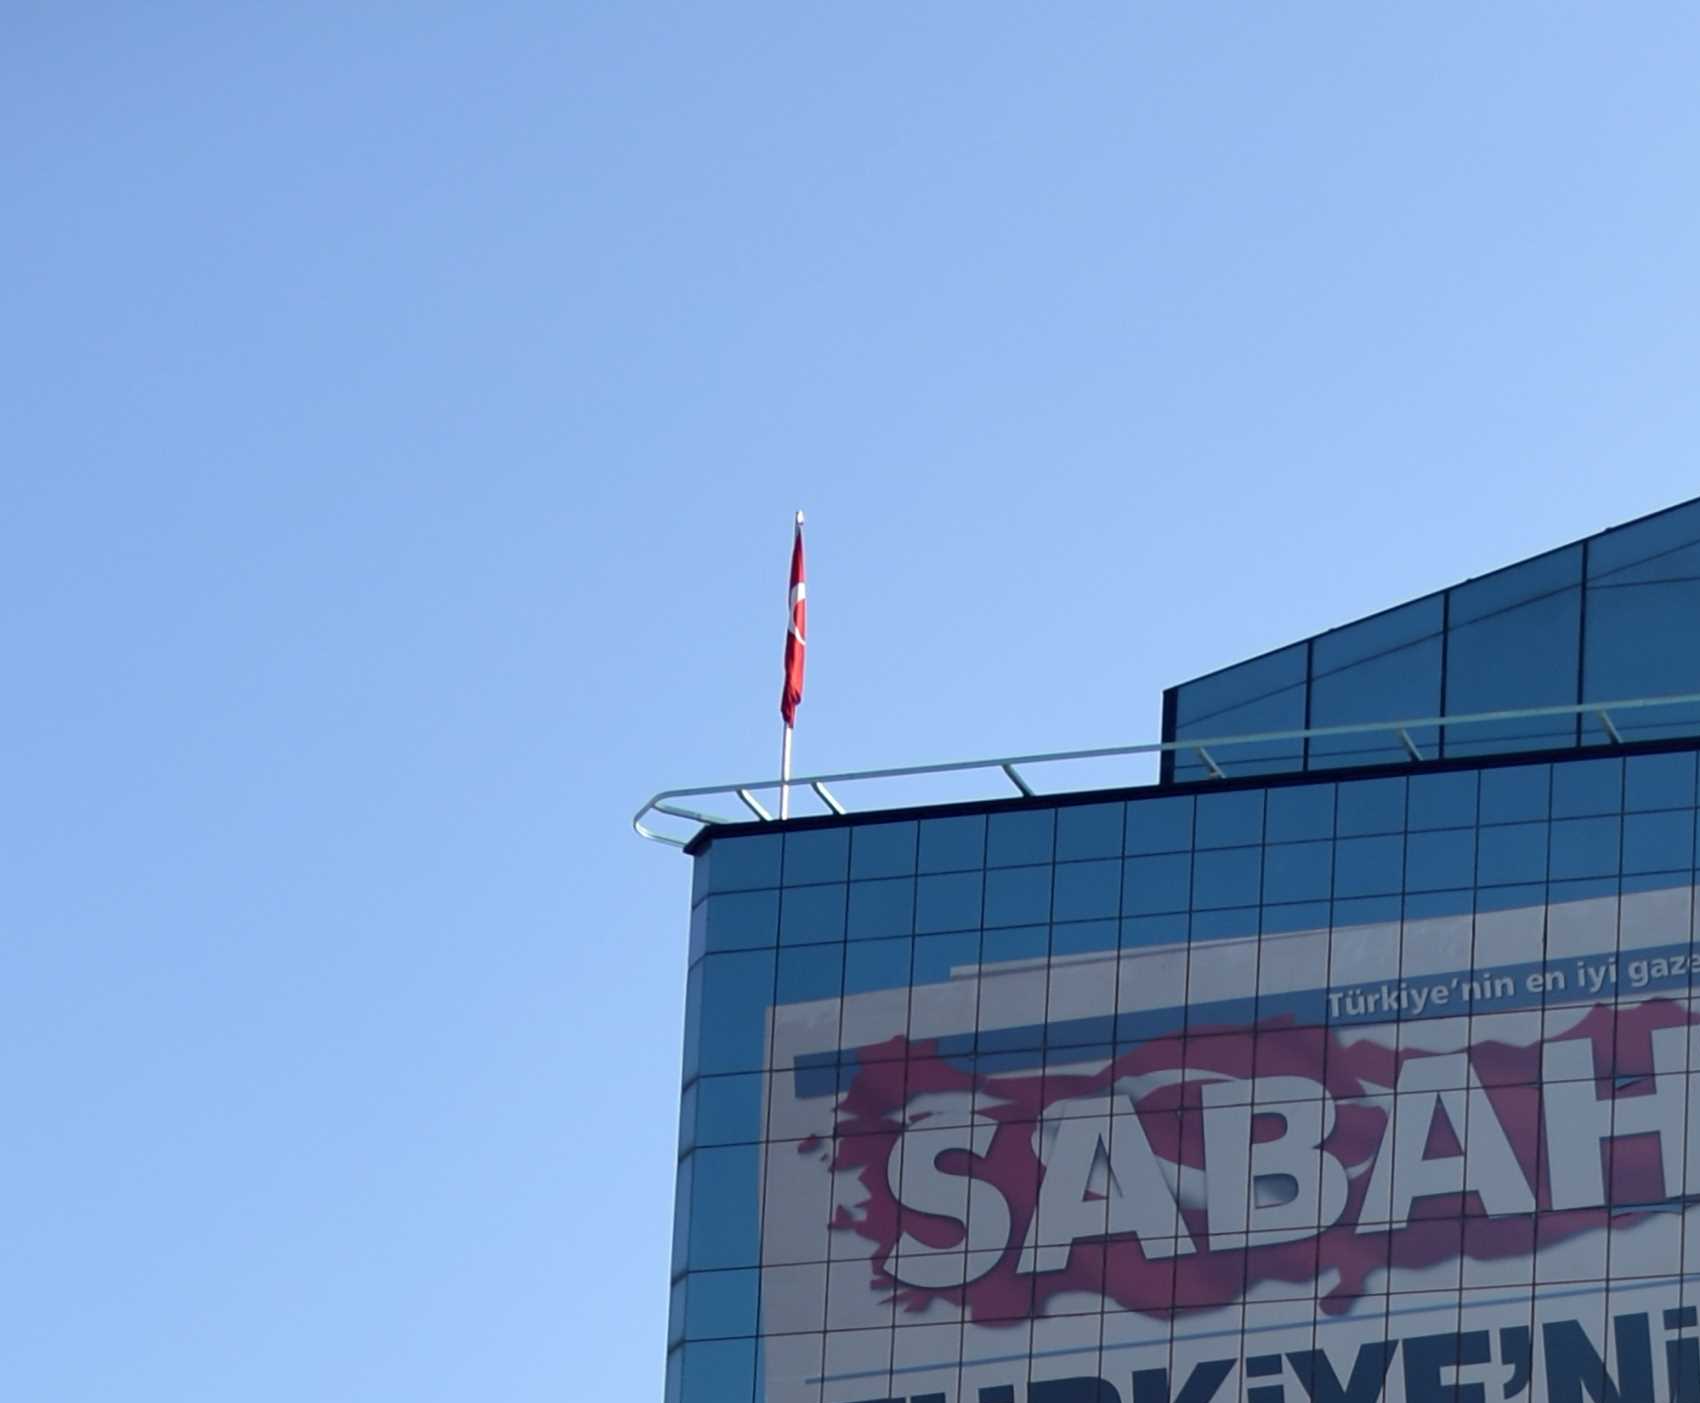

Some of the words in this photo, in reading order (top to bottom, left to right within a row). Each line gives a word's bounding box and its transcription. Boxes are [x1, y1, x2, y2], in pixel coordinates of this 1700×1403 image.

[1328, 974, 1515, 1018] Türkiye'nin
[1526, 968, 1566, 995] en
[1576, 959, 1618, 992] iyi
